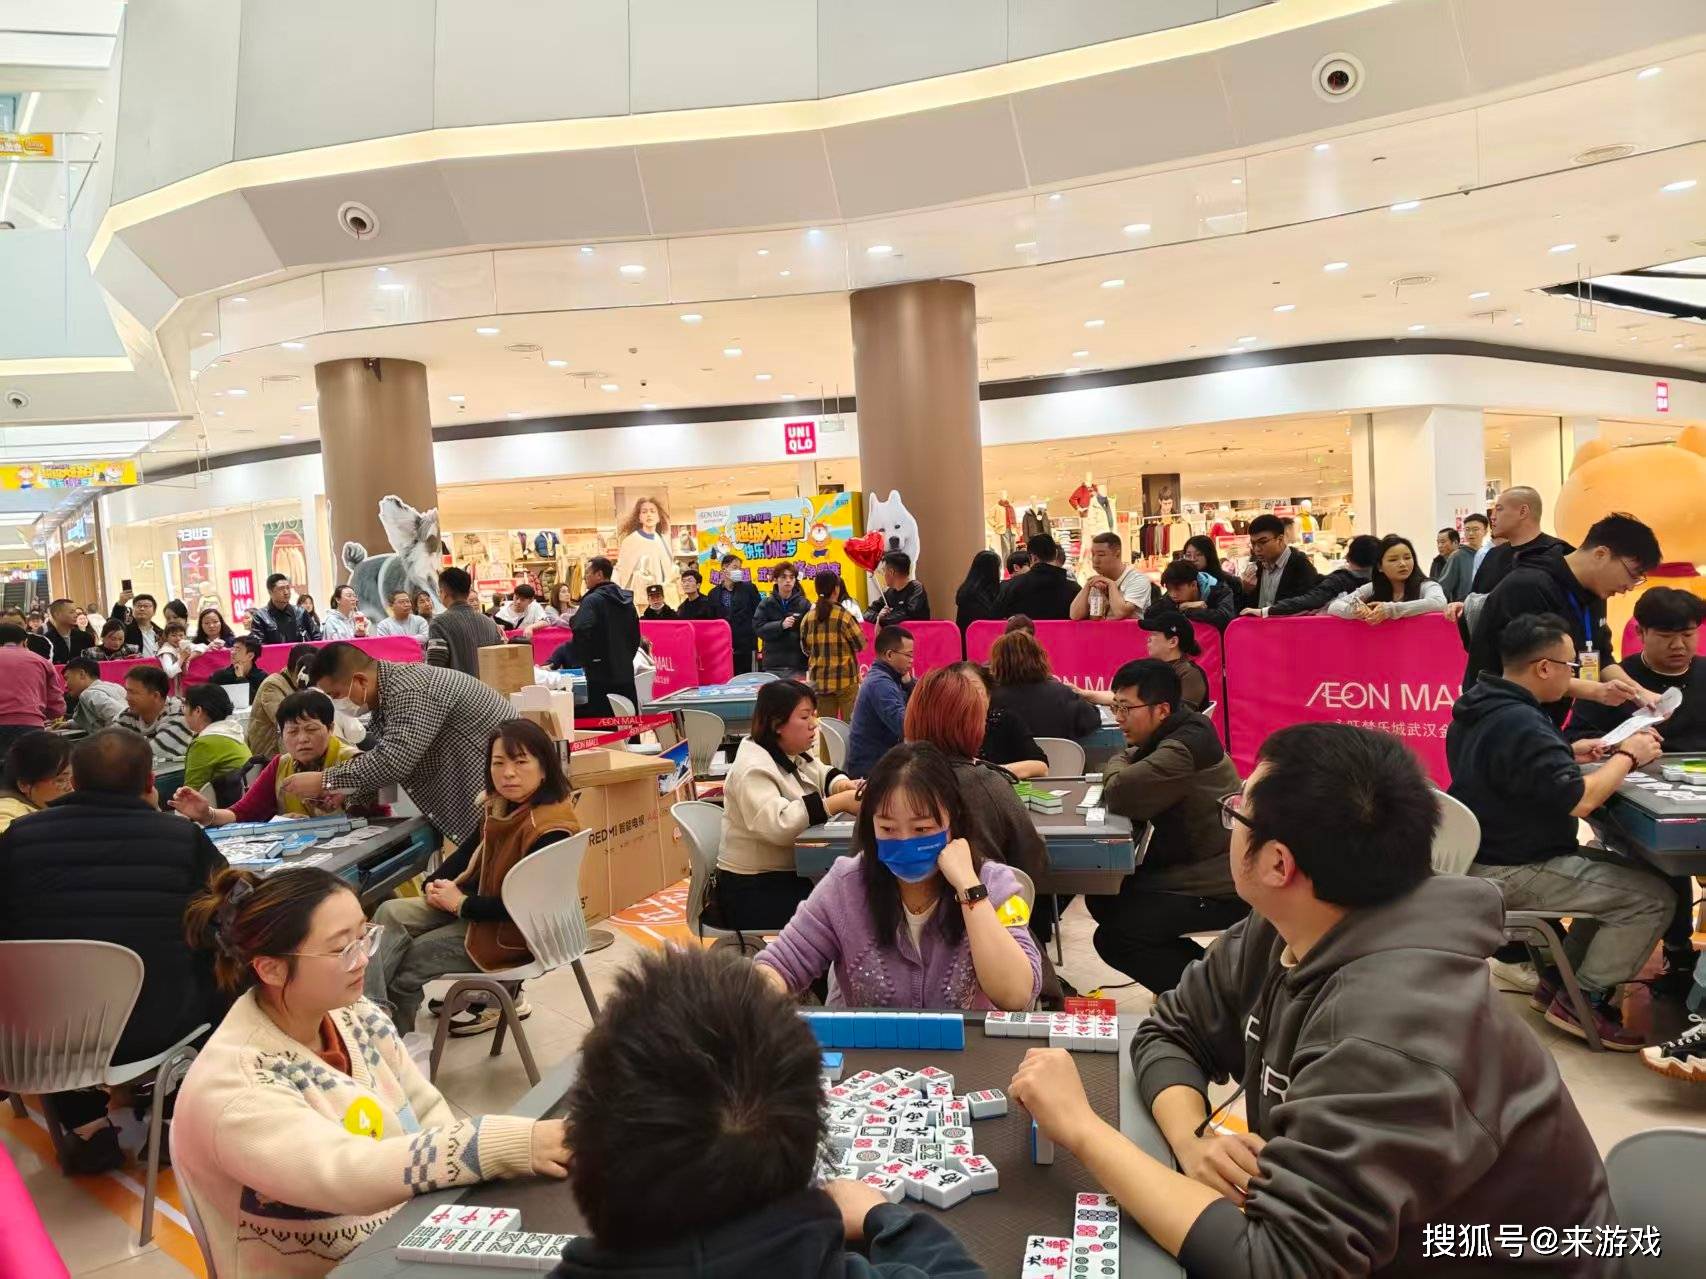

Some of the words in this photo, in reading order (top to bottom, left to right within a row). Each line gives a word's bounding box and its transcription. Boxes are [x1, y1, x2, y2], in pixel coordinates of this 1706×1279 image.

[787, 425, 811, 438] UNI
[788, 438, 813, 453] QLO
[231, 576, 250, 595] UNI
[588, 825, 618, 847] REDMI
